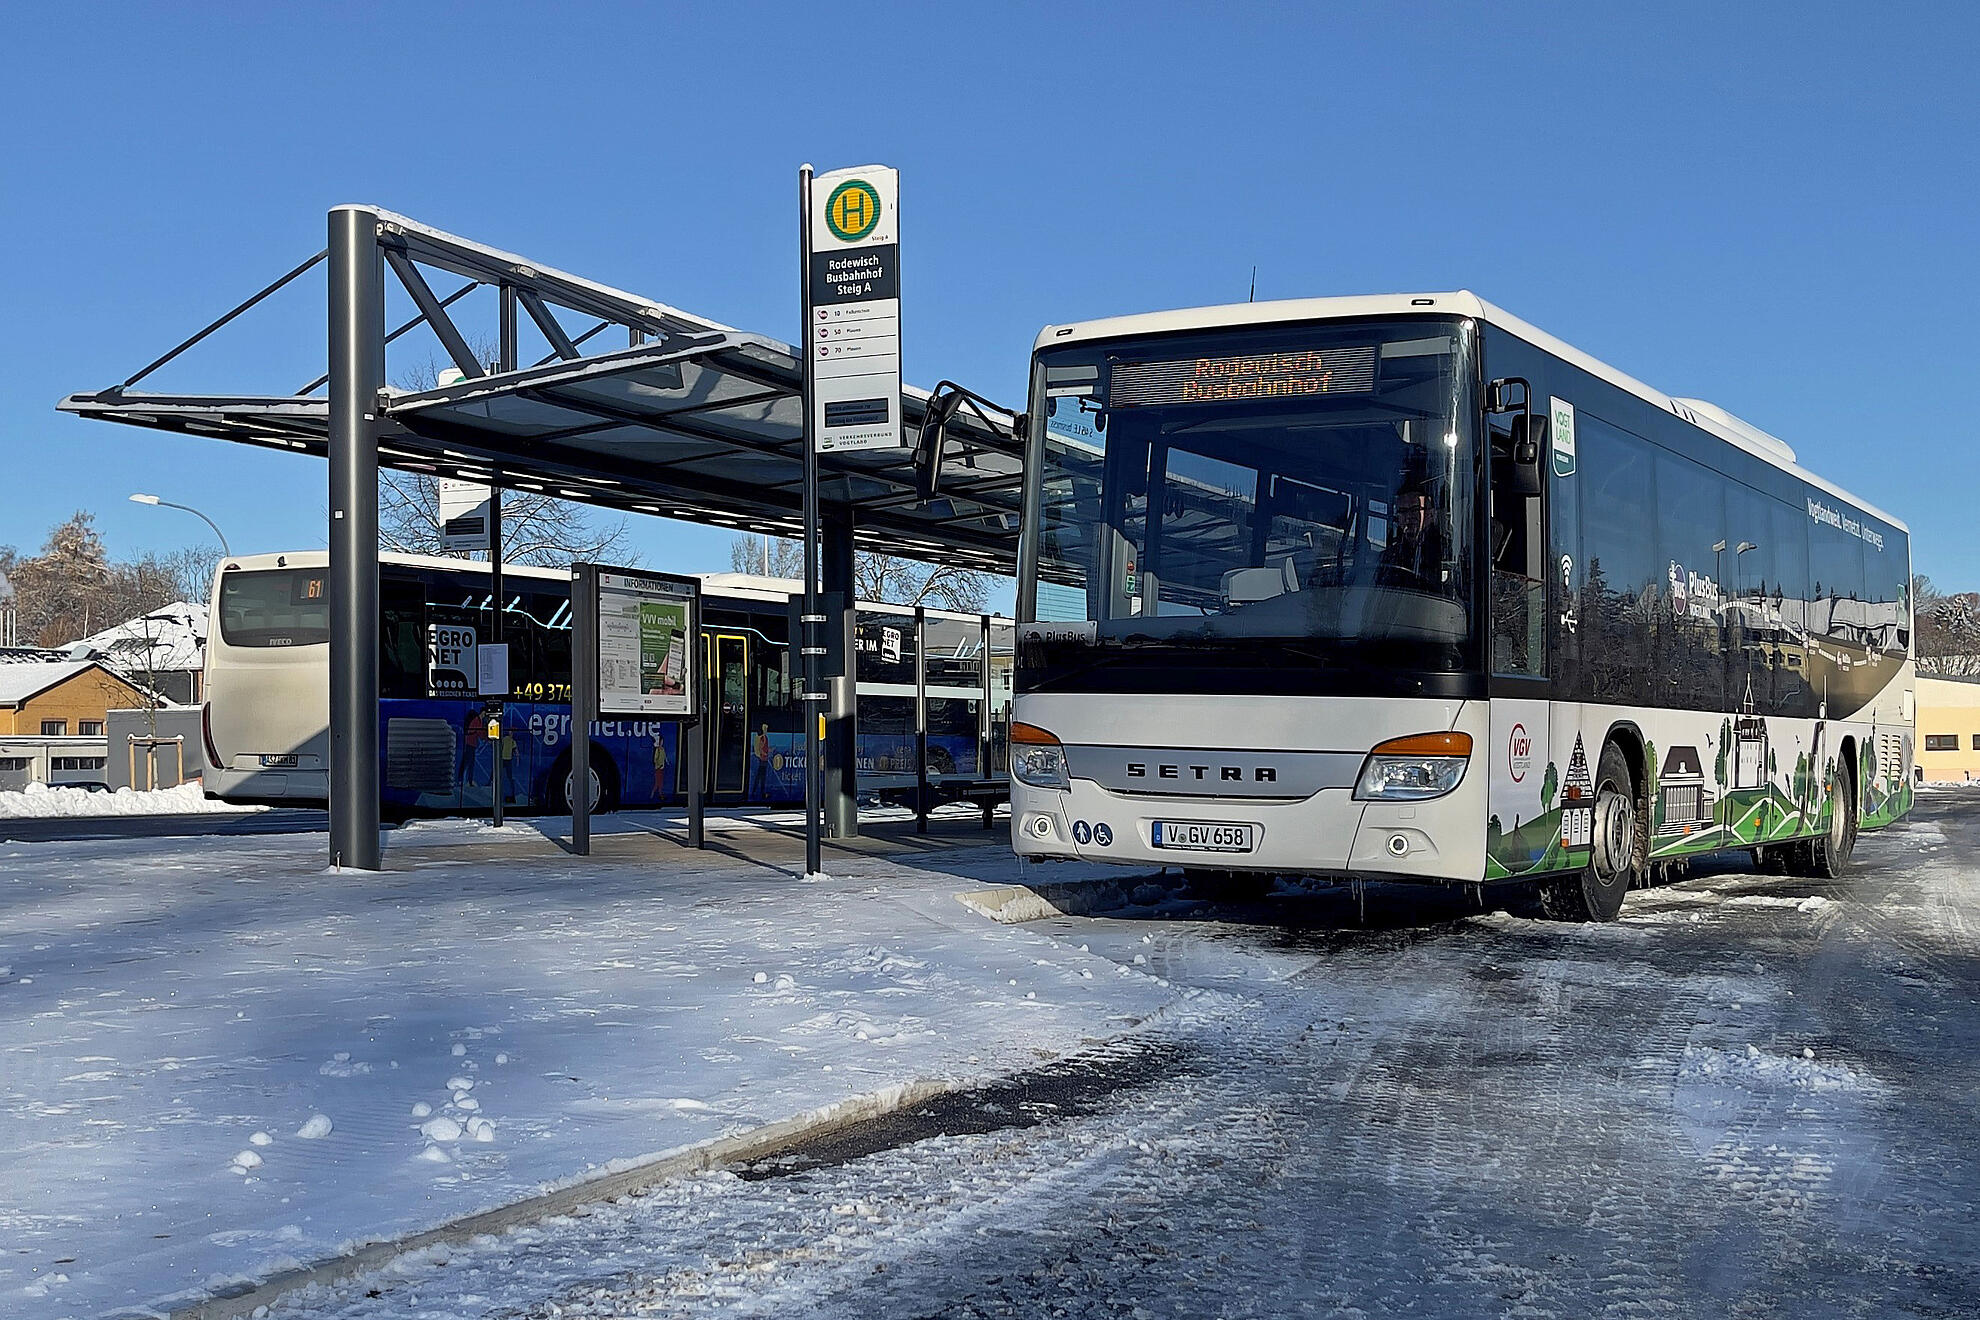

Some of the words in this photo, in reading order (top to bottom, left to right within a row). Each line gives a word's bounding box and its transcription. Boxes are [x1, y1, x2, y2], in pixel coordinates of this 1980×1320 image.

[829, 255, 879, 270] Rodewisch
[826, 267, 883, 284] Busbahnhof
[837, 283, 862, 296] Steig
[863, 281, 872, 292] A
[309, 580, 321, 598] 61
[623, 577, 674, 593] INFORMATIONEN
[1688, 570, 1719, 602] PlusBus
[269, 637, 292, 647] IVECO
[428, 629, 473, 648] EGRO
[429, 648, 462, 665] NET
[1514, 738, 1531, 757] VGV
[1126, 762, 1278, 783] SETRA
[1168, 825, 1179, 843] V
[1189, 826, 1210, 846] GV
[1213, 828, 1244, 846] 658
